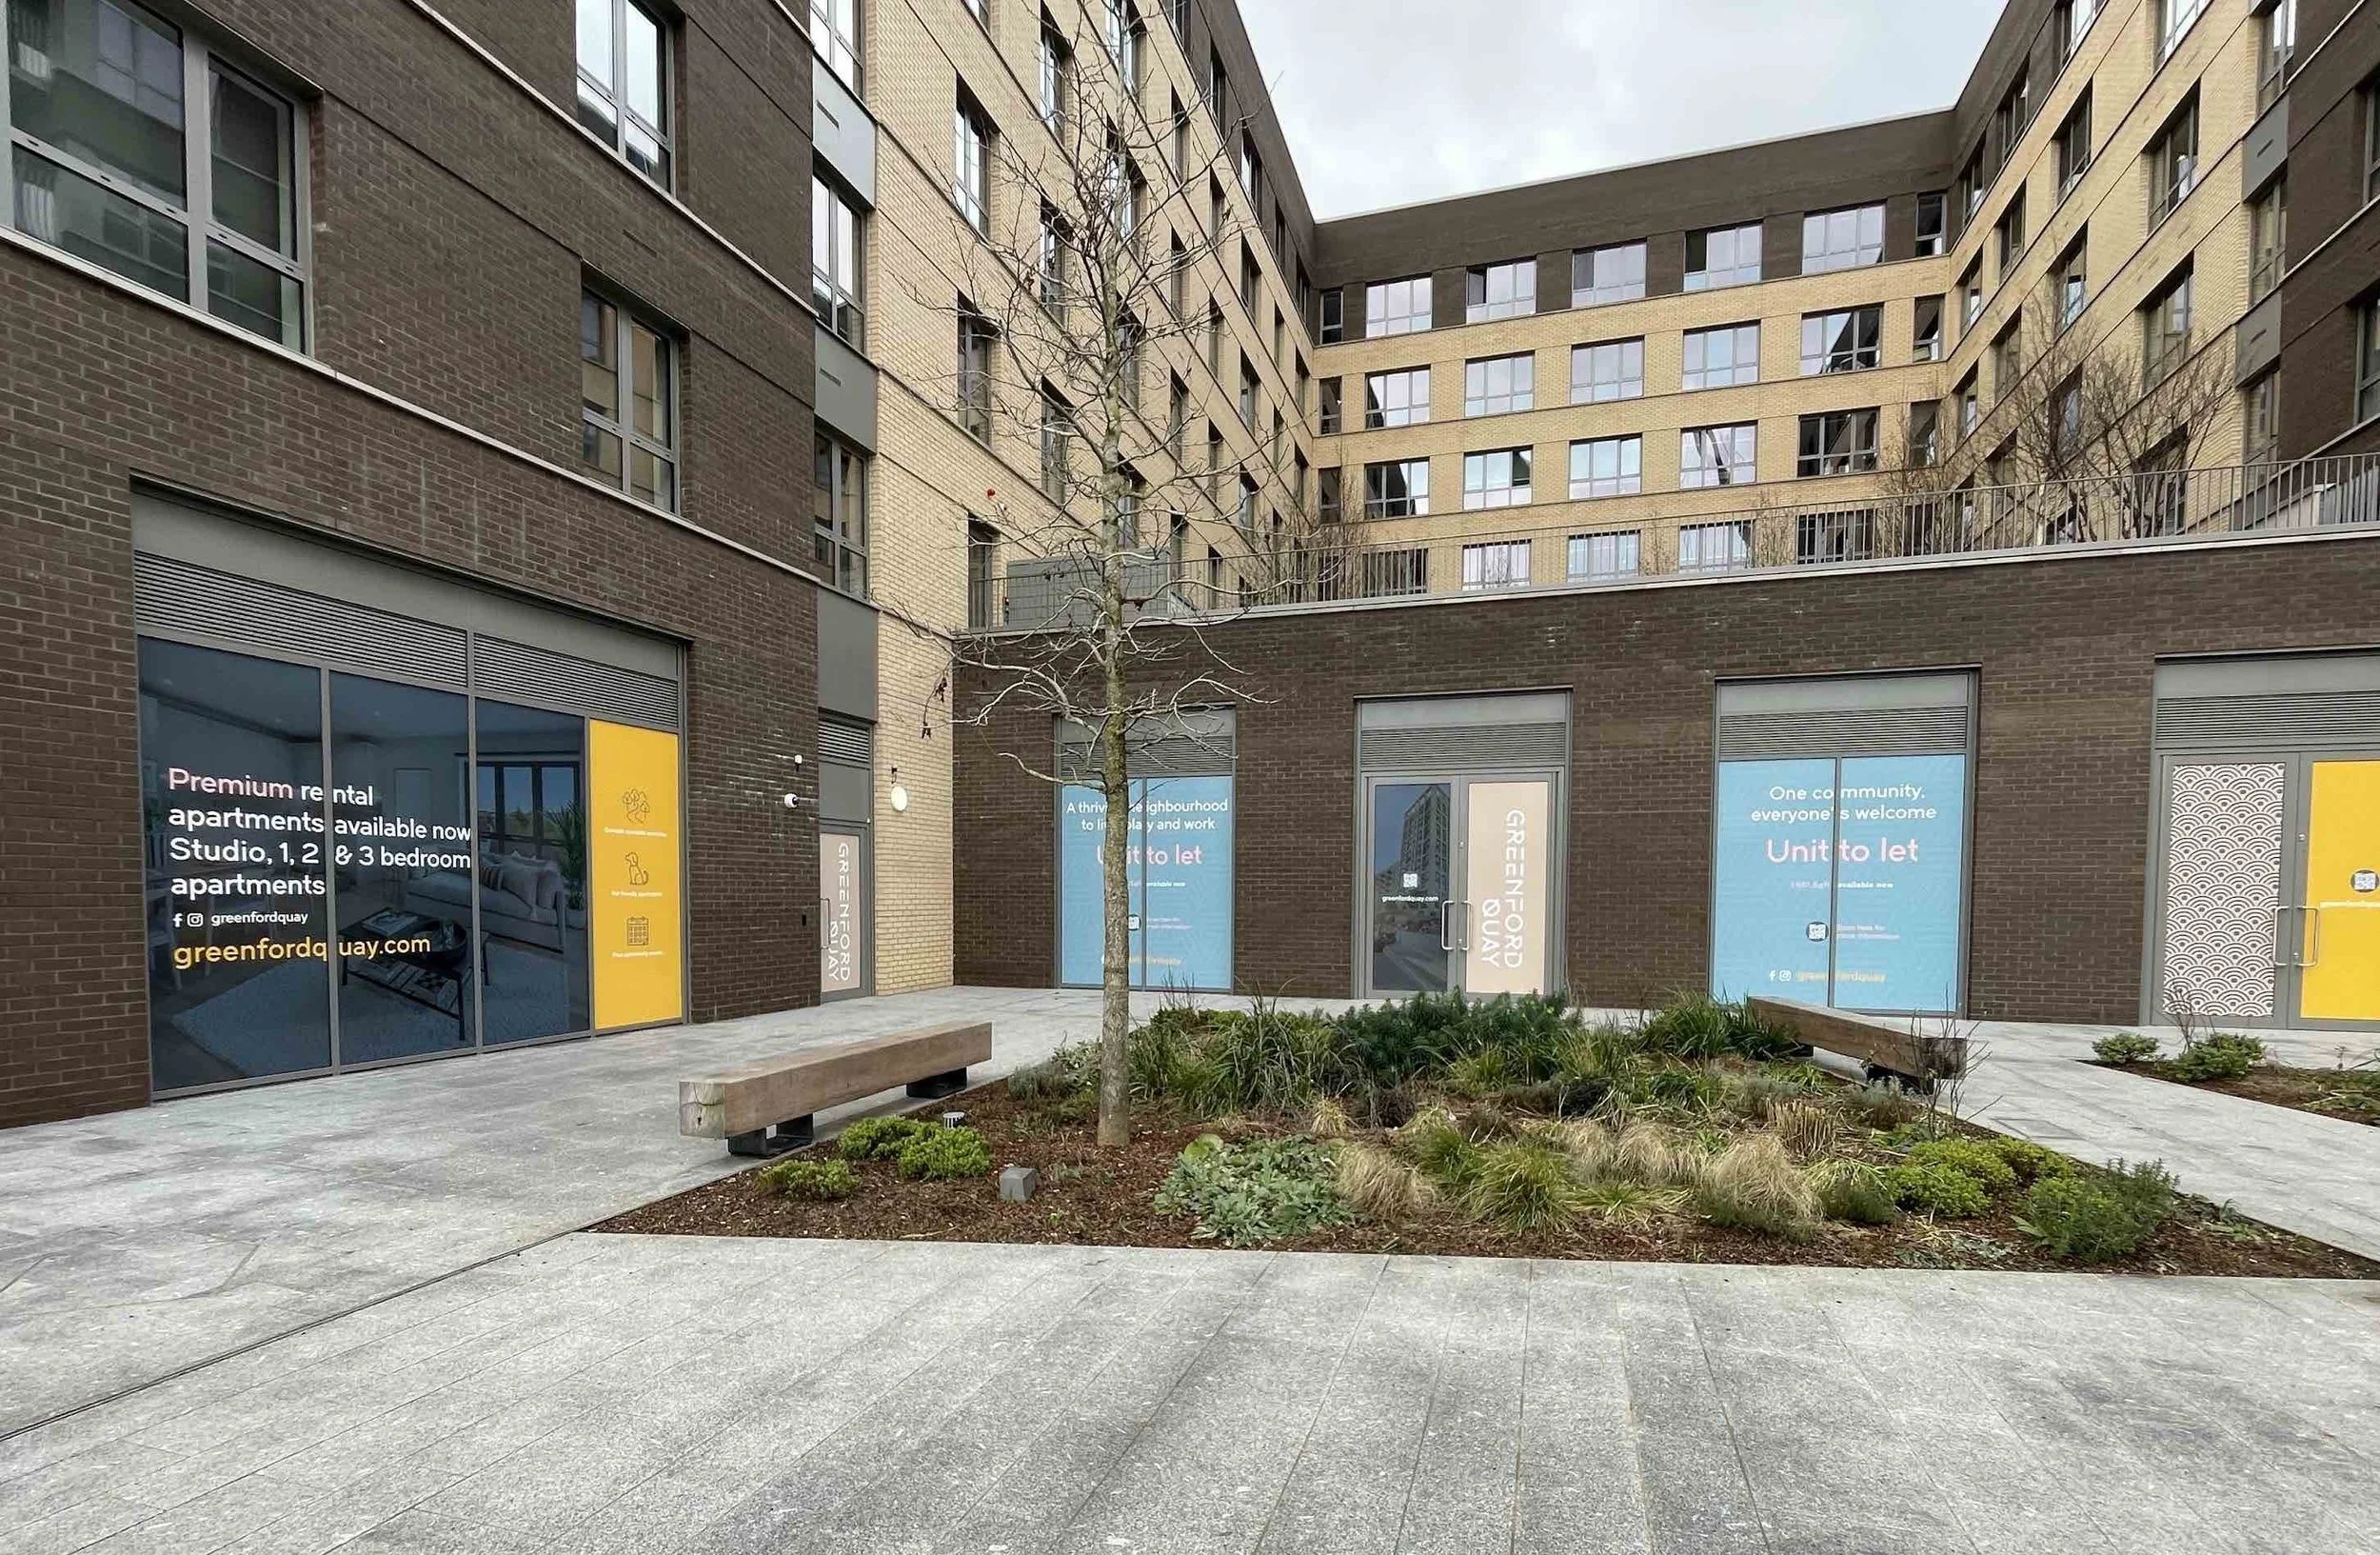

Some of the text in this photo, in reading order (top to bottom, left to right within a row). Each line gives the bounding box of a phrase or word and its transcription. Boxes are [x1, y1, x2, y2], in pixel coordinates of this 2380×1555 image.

[169, 767, 373, 806] Premium rental
[1769, 786, 1807, 801] One
[1066, 802, 1077, 814] A
[1855, 805, 1937, 821] welcome
[169, 807, 471, 842] apartments available now
[1081, 819, 1094, 830] to
[1158, 817, 1180, 830] and
[1184, 816, 1215, 830] work
[169, 837, 470, 868] Studio, 1, 2 & 3 bedroom
[1146, 846, 1168, 865] to
[1176, 843, 1202, 866] let
[1767, 837, 1919, 864] Unit to let
[170, 873, 326, 900] apartments
[1505, 809, 1525, 967] GREENFORD
[210, 910, 308, 927] greenfordquay
[838, 842, 850, 981] GREENFORD
[1481, 899, 1501, 967] QUAY
[173, 936, 431, 969] greenfordquay.com
